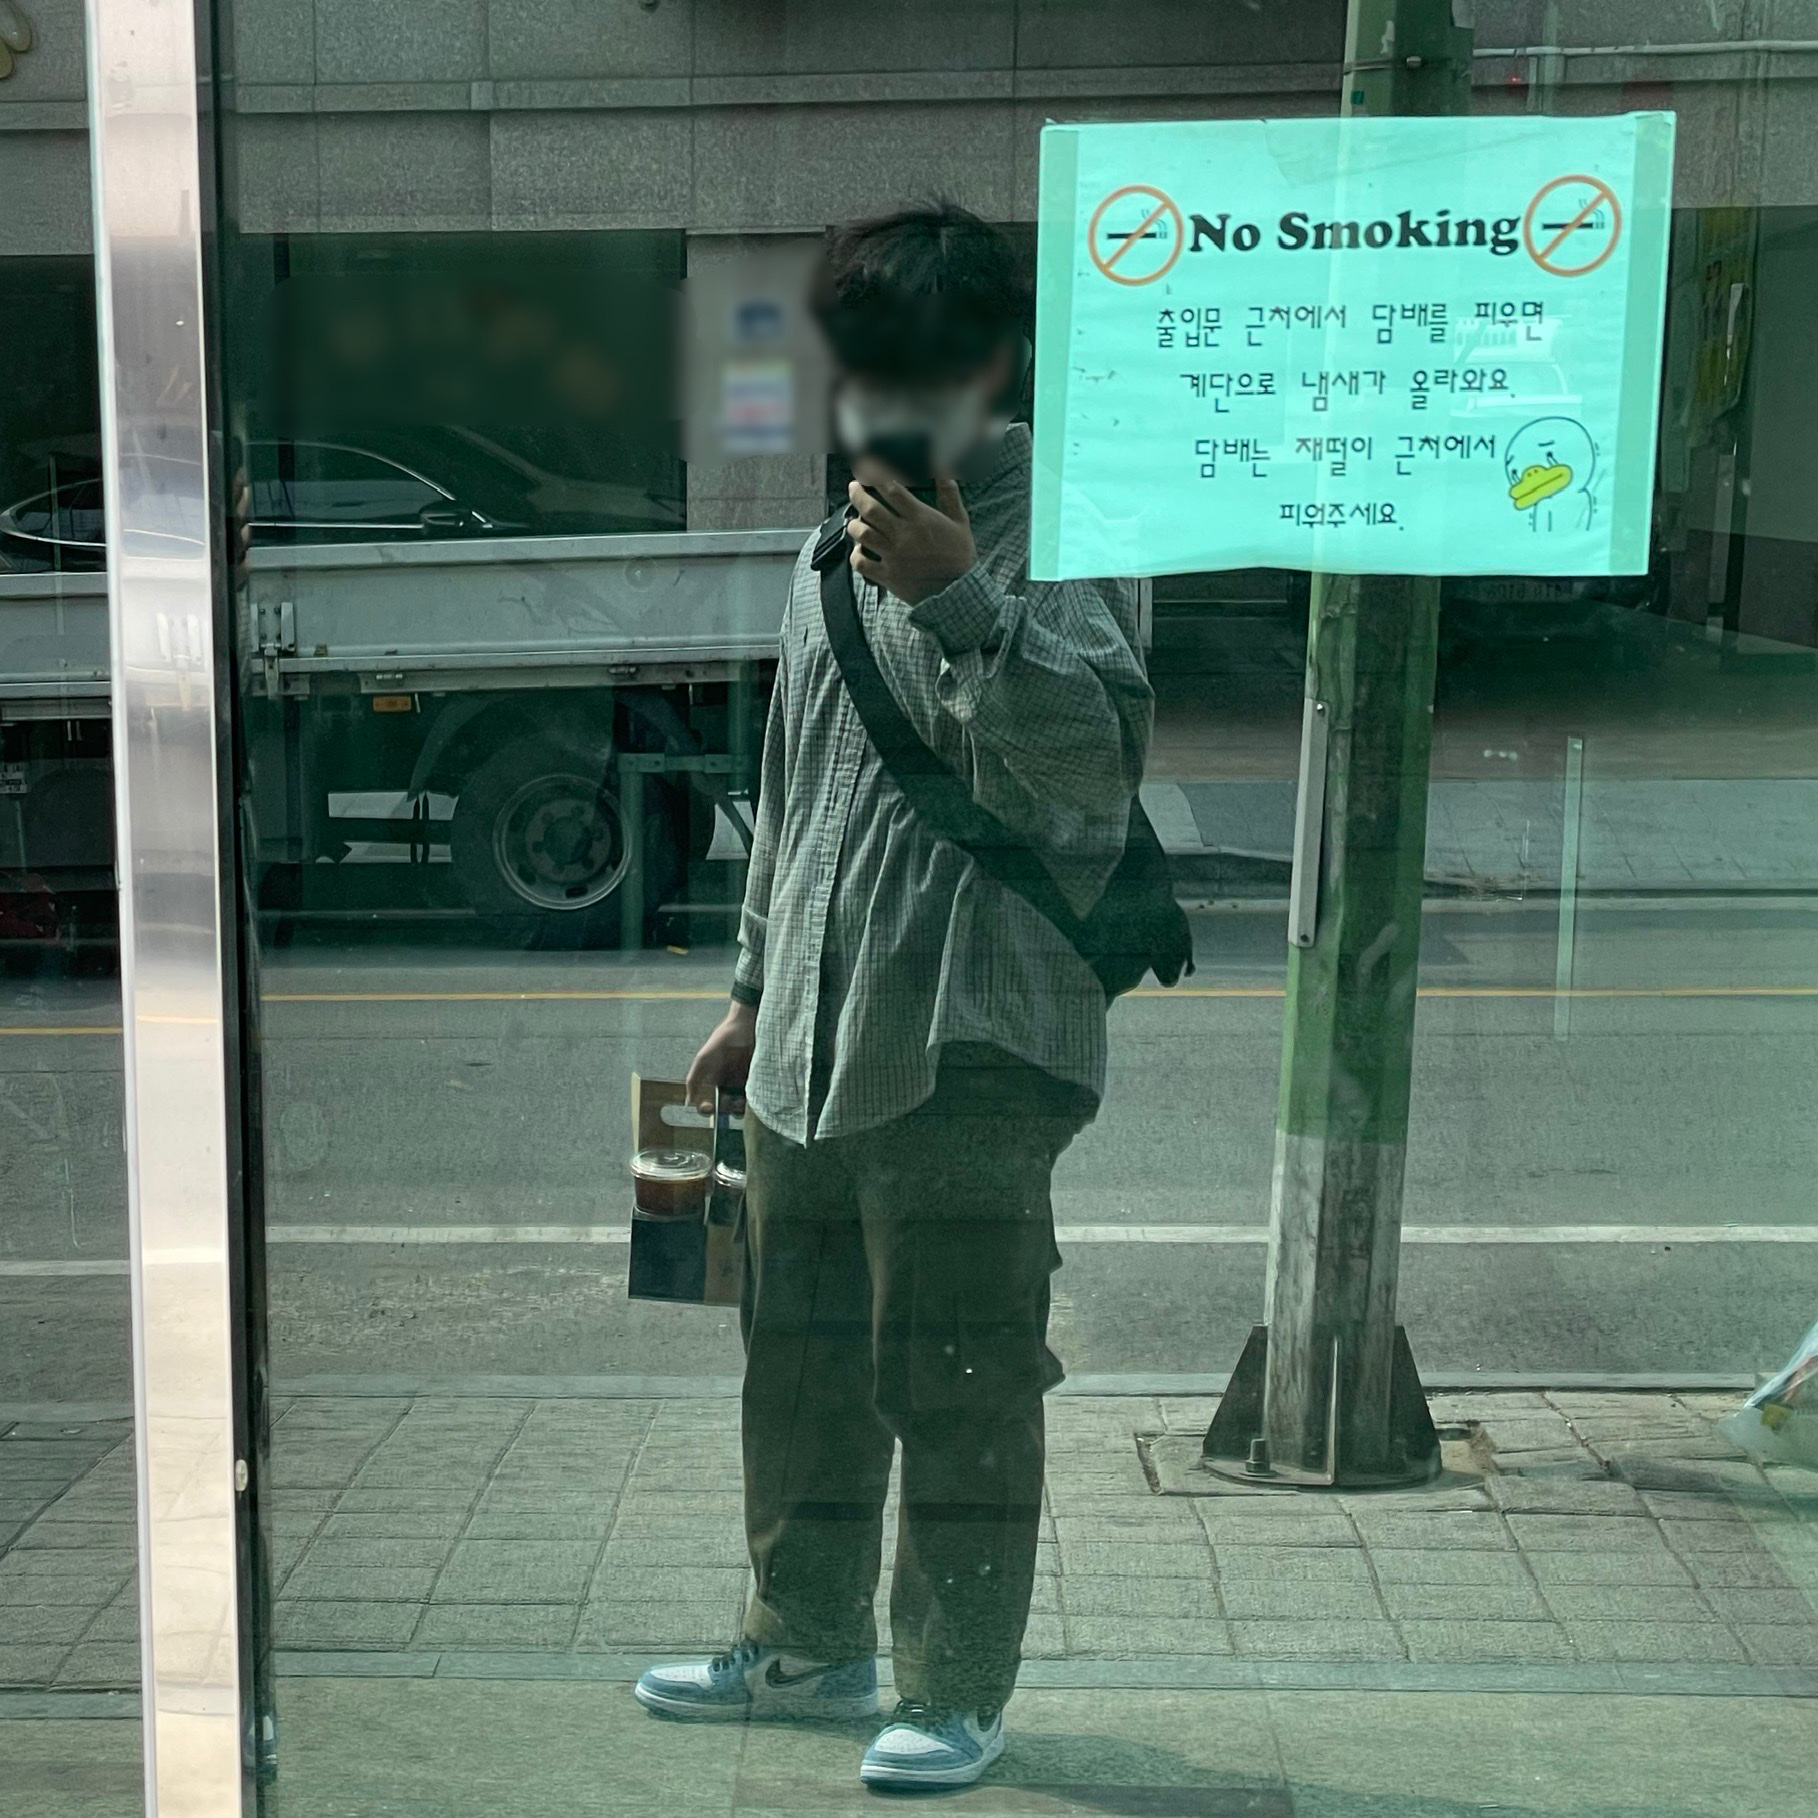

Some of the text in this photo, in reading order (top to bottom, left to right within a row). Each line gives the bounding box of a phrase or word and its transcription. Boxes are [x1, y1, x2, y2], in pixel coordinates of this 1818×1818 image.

[1188, 209, 1521, 256] No Smoking
[1155, 300, 1544, 349] 출입문 근처에서 담배를 피우면
[1179, 367, 1516, 414] 계단으로 냄새가 올라와요.
[1194, 434, 1496, 479] 담배는 재떨이 근처에서
[1279, 502, 1405, 532] 피워주세요.
